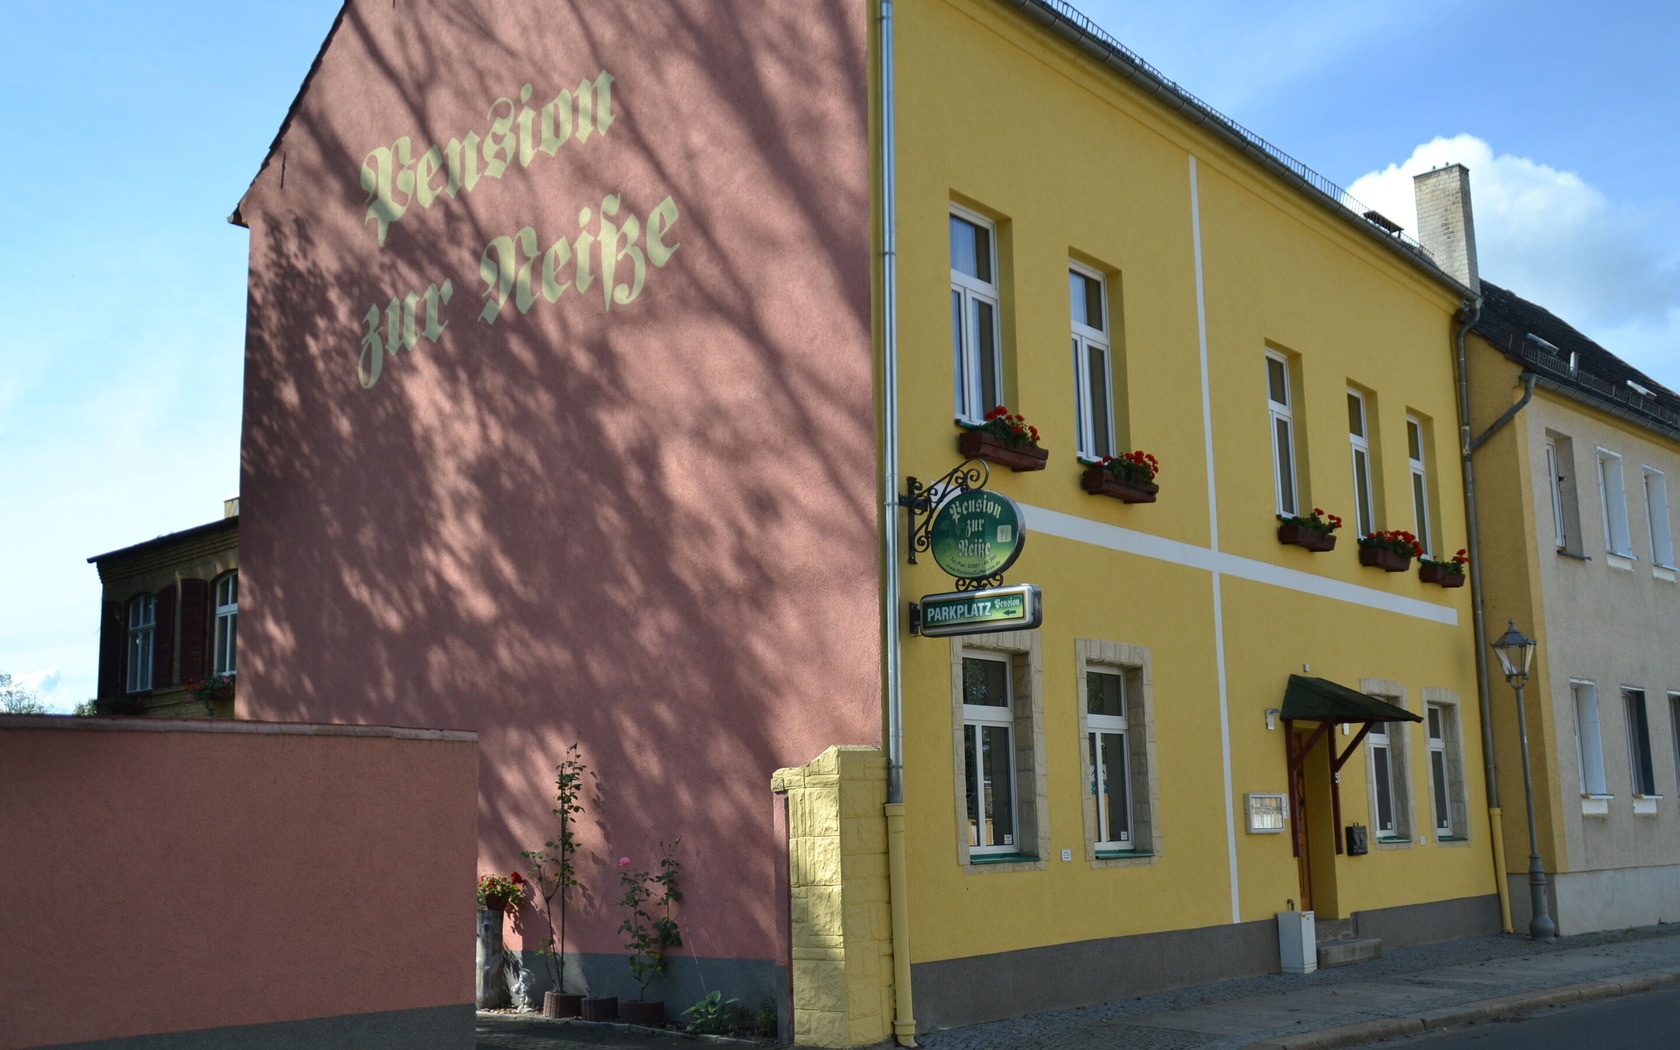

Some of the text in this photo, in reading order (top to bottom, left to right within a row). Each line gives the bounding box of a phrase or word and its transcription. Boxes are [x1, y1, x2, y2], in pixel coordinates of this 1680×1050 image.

[360, 69, 615, 247] Pension
[358, 192, 680, 389] zur Neiße
[950, 494, 1001, 526] Pension
[966, 518, 985, 538] zur
[958, 538, 991, 559] Neiße
[927, 597, 1020, 622] PARKPLATZ Pension
